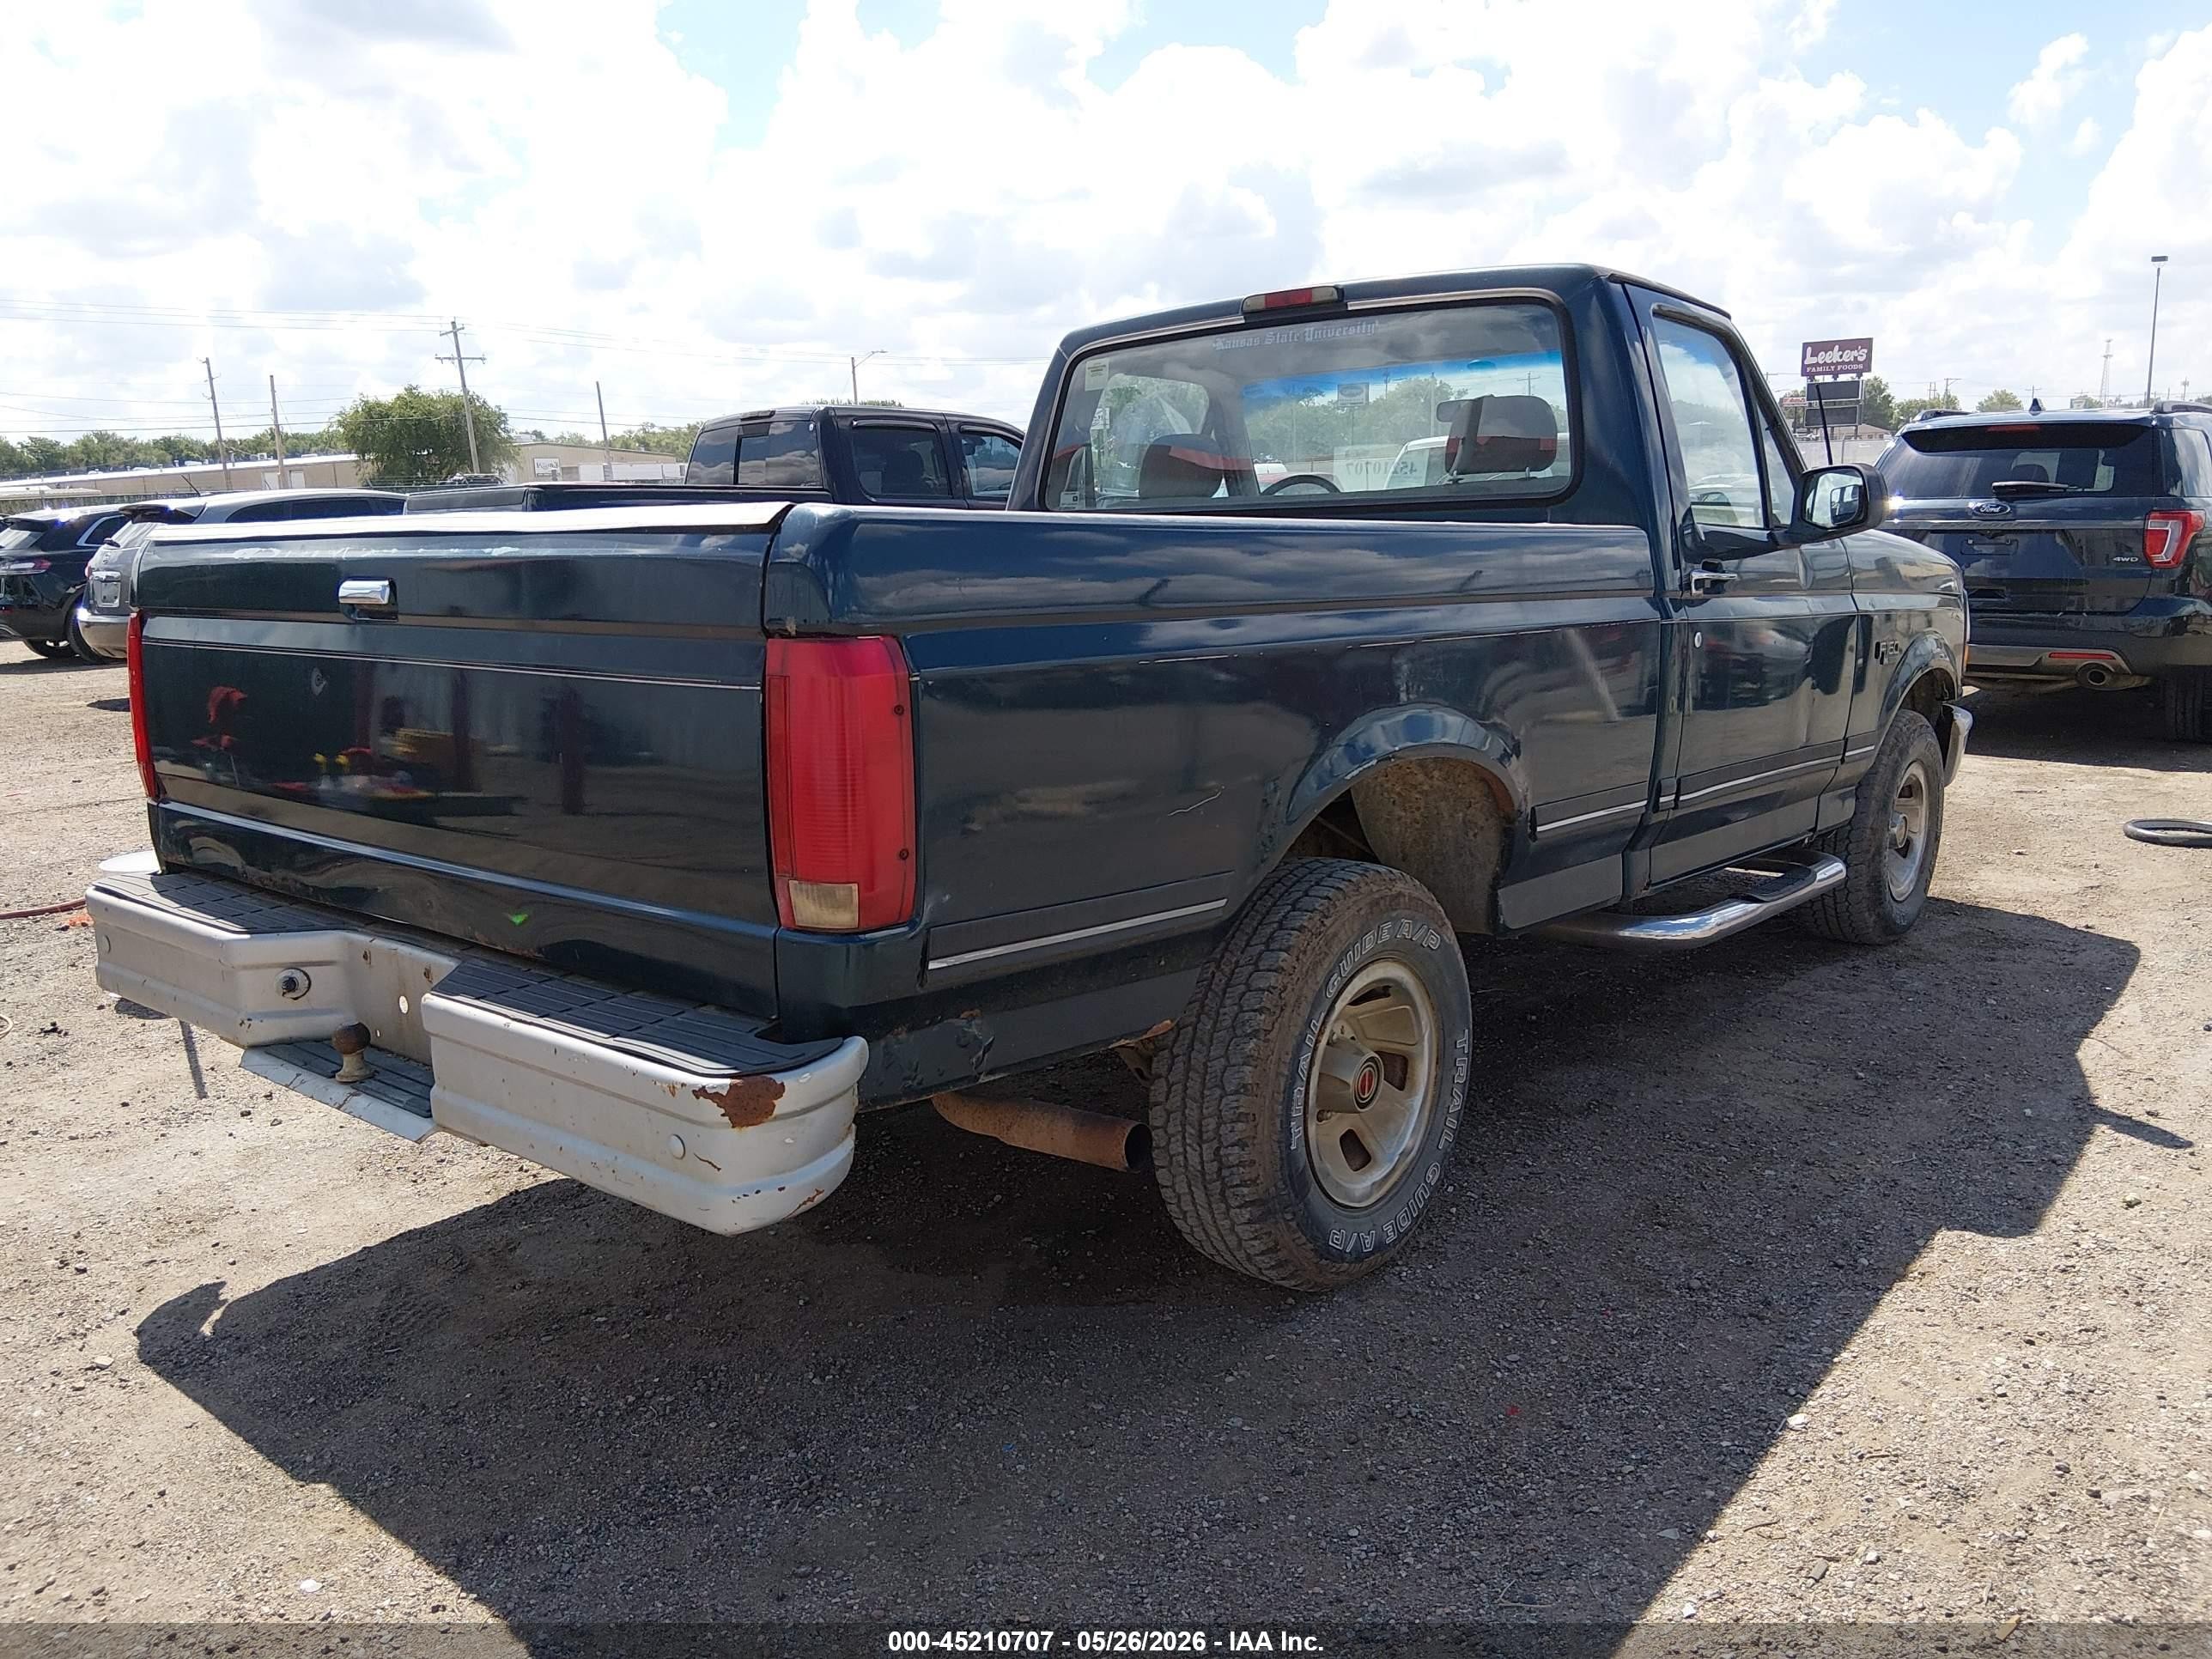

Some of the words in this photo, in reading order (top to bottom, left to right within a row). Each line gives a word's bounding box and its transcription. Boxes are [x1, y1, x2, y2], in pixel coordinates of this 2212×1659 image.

[1212, 337, 1261, 350] Kansas
[1264, 331, 1300, 344] State
[1804, 344, 1868, 365] Leeker's
[1290, 1012, 1326, 1151] TRAIL
[1325, 921, 1393, 999] GUIDE
[1395, 918, 1442, 951] A/P
[1437, 1028, 1469, 1150] TRAIL
[1382, 1162, 1441, 1244] GUIDE
[1328, 1229, 1376, 1253] A/P
